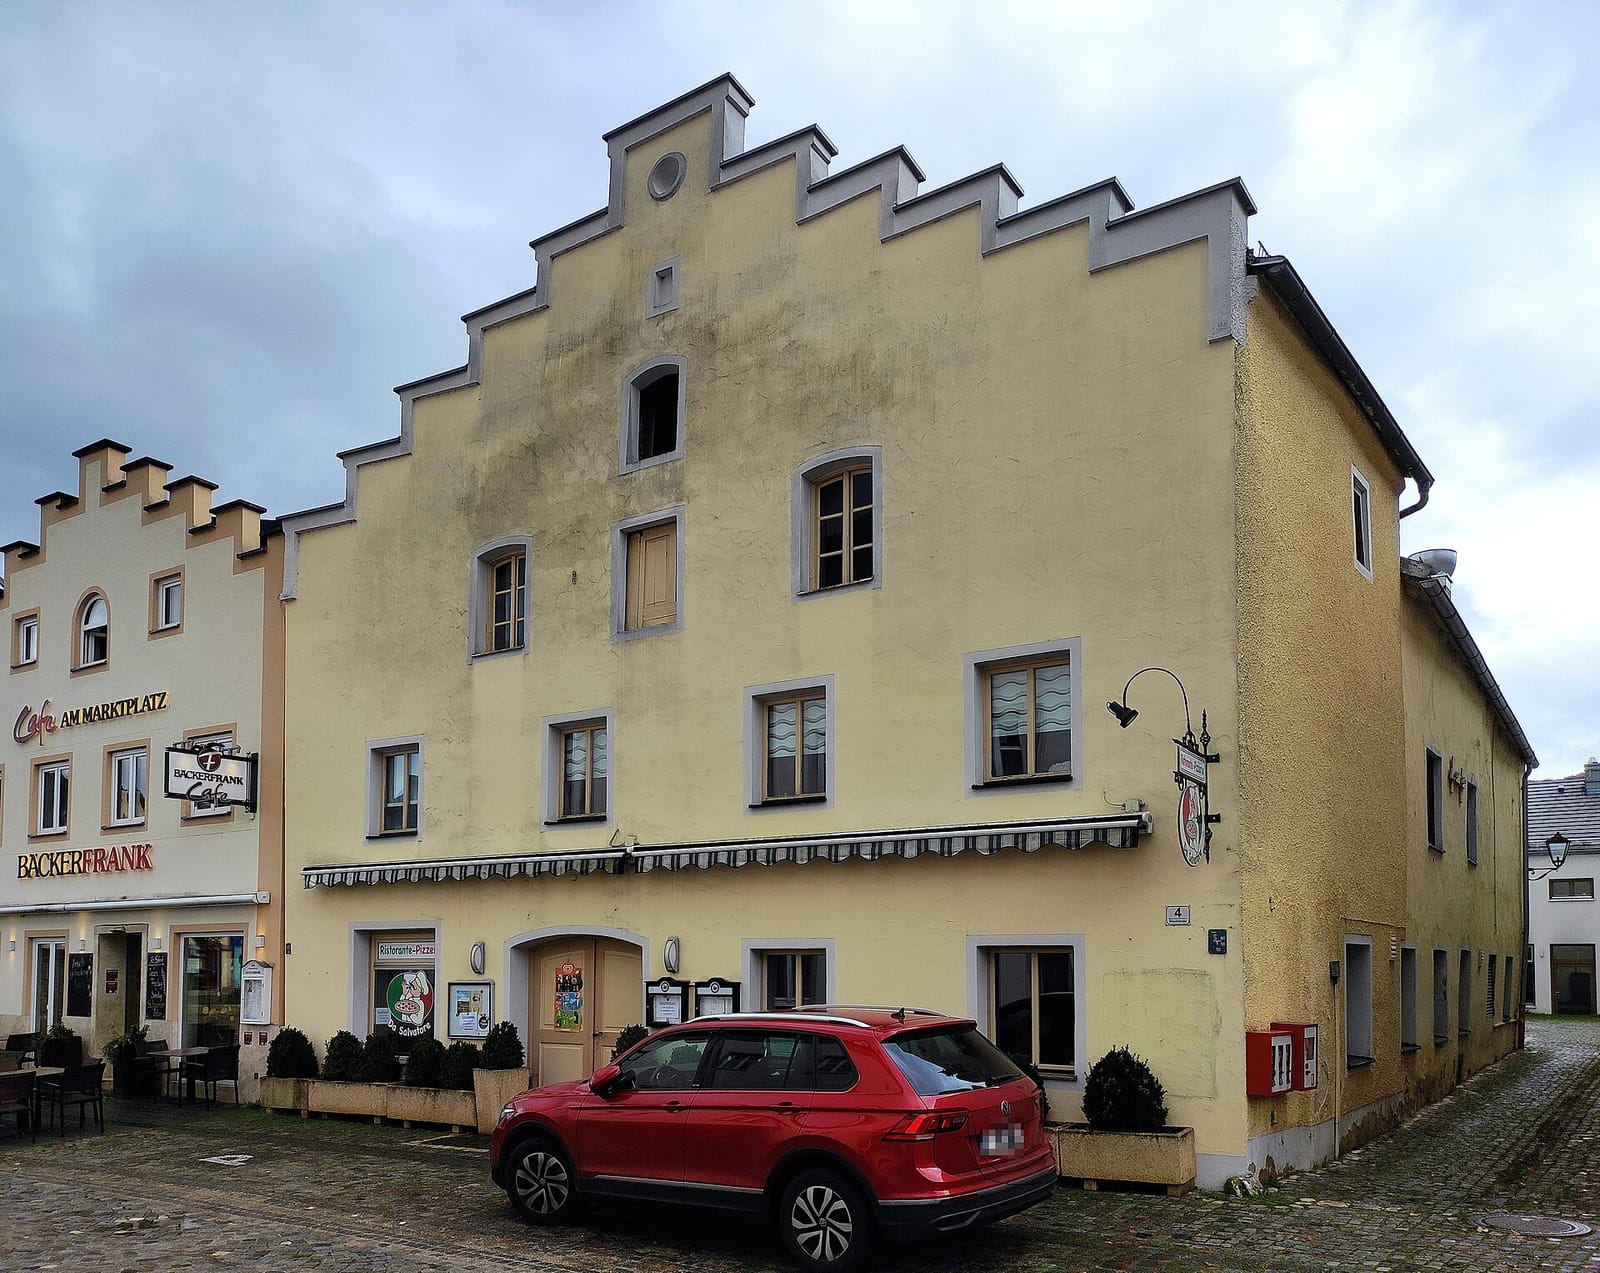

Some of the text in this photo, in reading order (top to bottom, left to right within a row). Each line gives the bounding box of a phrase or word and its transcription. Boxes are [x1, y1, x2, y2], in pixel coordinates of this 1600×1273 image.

[60, 709, 81, 728] AM
[82, 692, 168, 723] MARKTPLATZ
[17, 843, 153, 878] BÄCKERFRANK
[1174, 907, 1182, 918] 4
[387, 1019, 432, 1037] Da Salvatore
